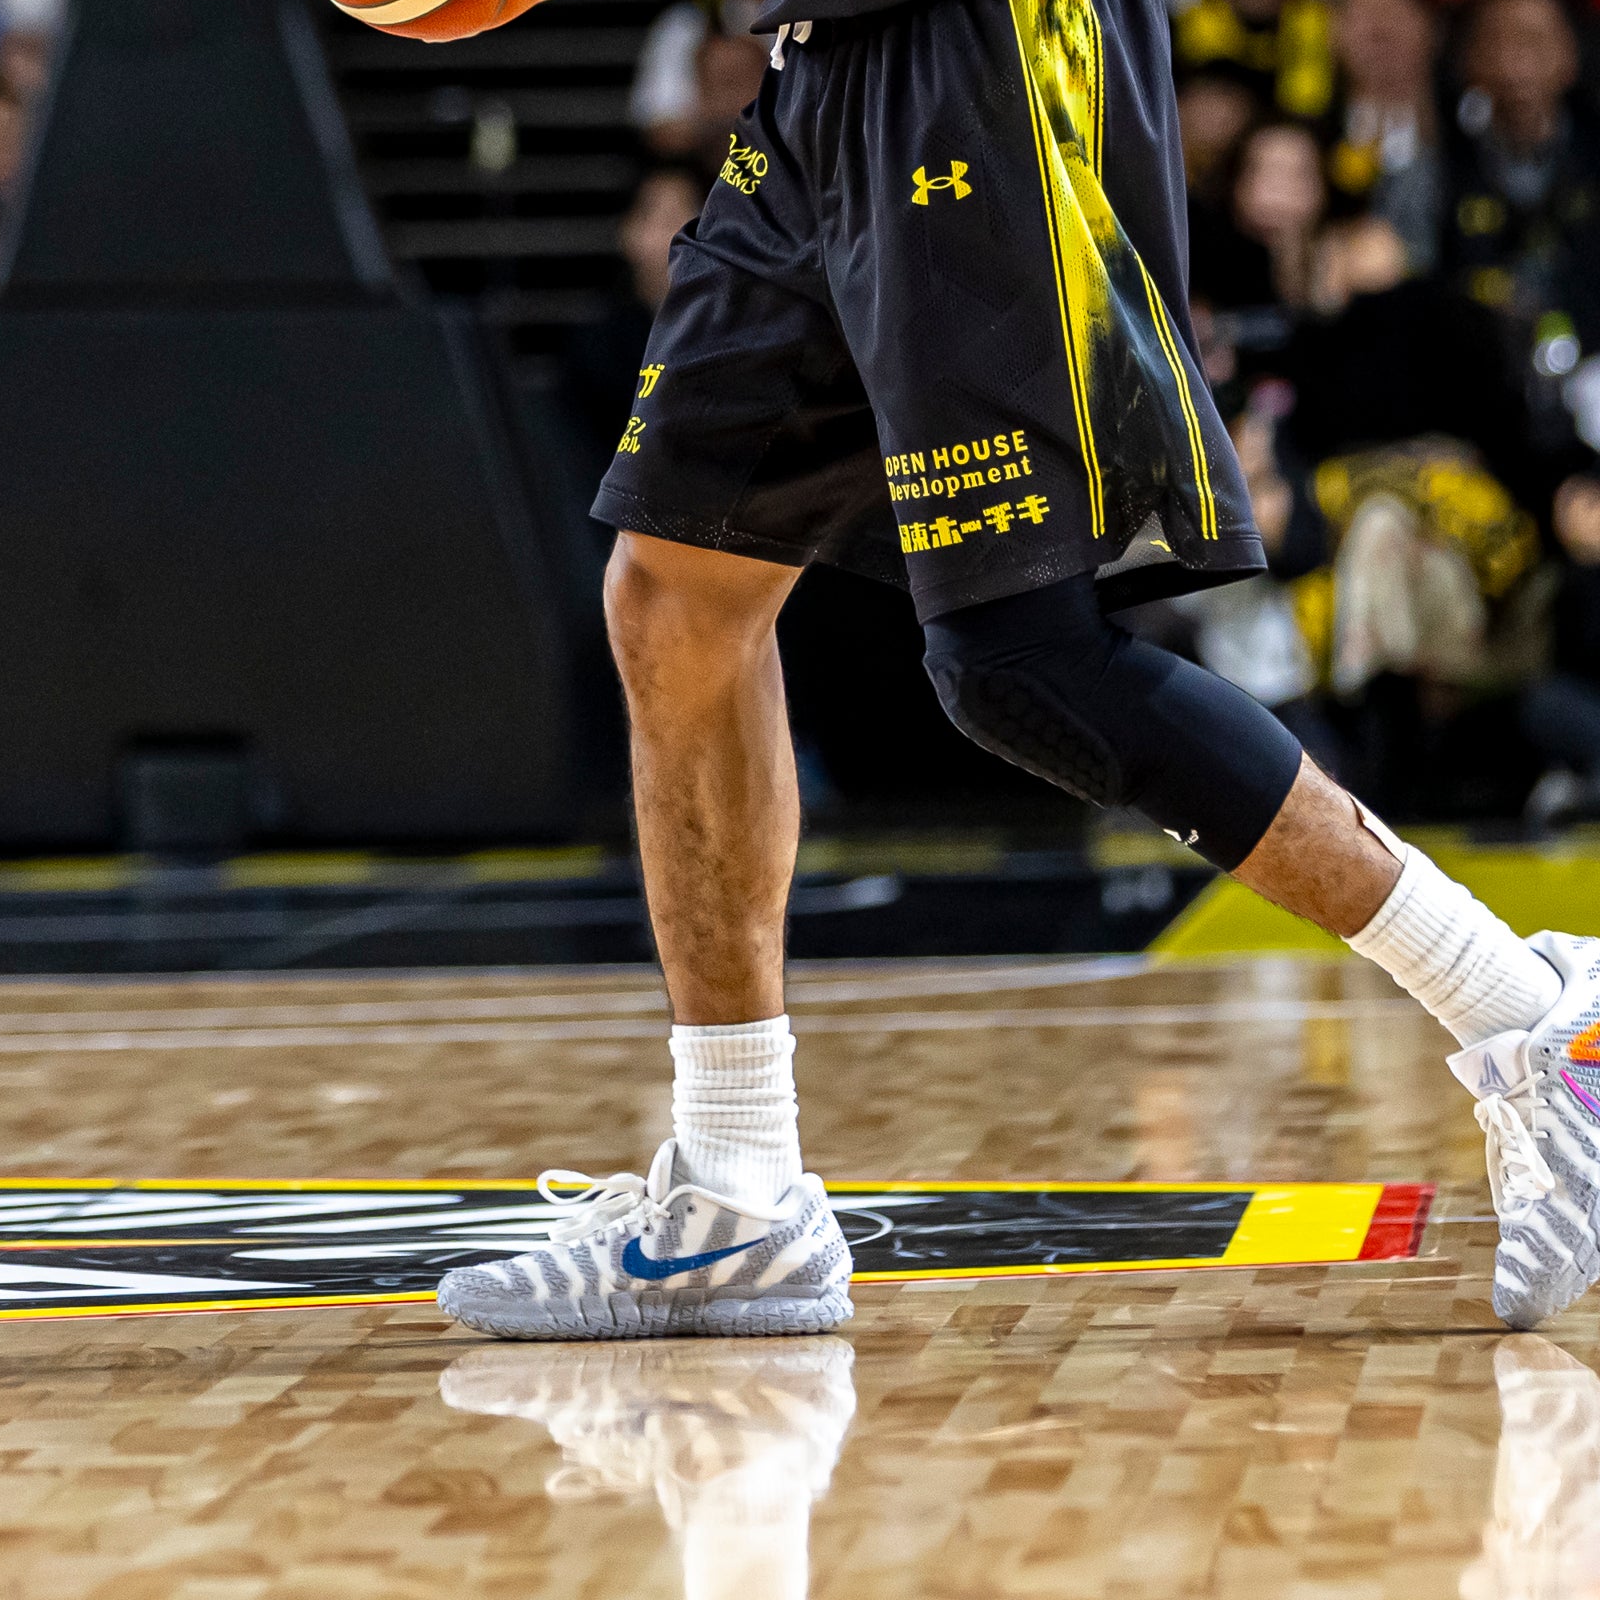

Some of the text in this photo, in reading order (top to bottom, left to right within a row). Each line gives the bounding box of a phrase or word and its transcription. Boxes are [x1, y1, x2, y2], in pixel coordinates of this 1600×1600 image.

[885, 429, 1029, 477] OPEN HOUSE
[888, 455, 1033, 502] Development
